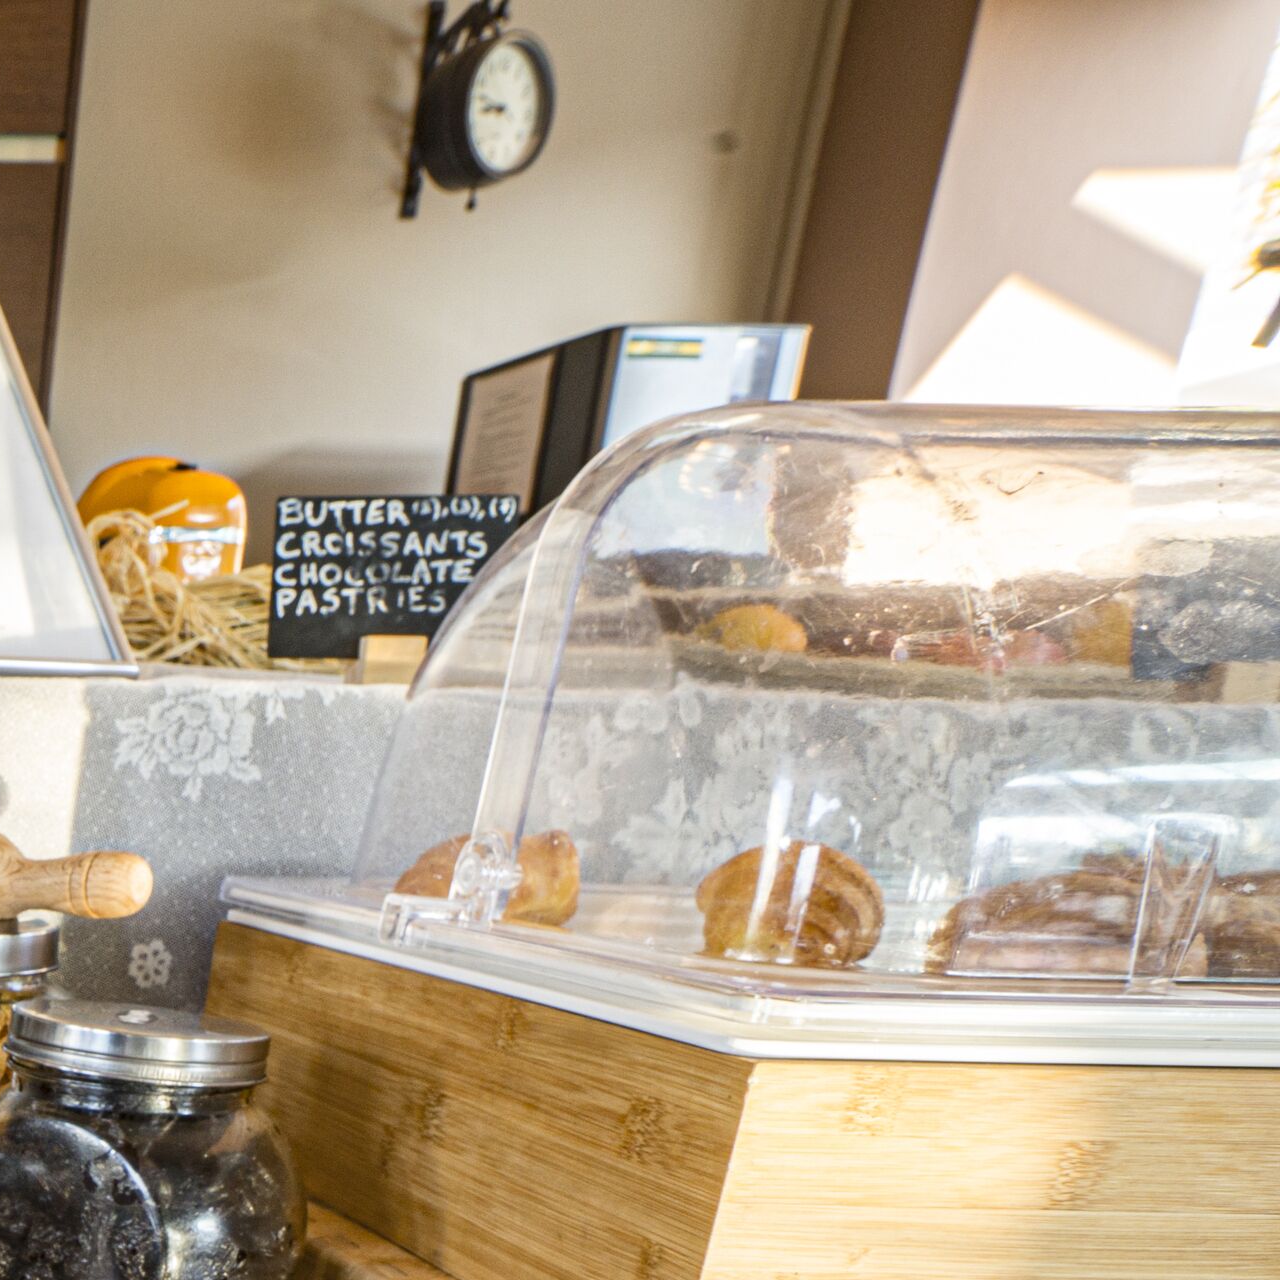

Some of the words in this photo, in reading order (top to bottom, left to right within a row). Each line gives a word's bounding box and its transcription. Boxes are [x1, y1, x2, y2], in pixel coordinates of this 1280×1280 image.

[278, 498, 411, 529] BUTTER
[275, 529, 489, 560] CROISSANTS
[273, 556, 476, 588] CHOCOLATE
[274, 585, 447, 619] PASTRIES
